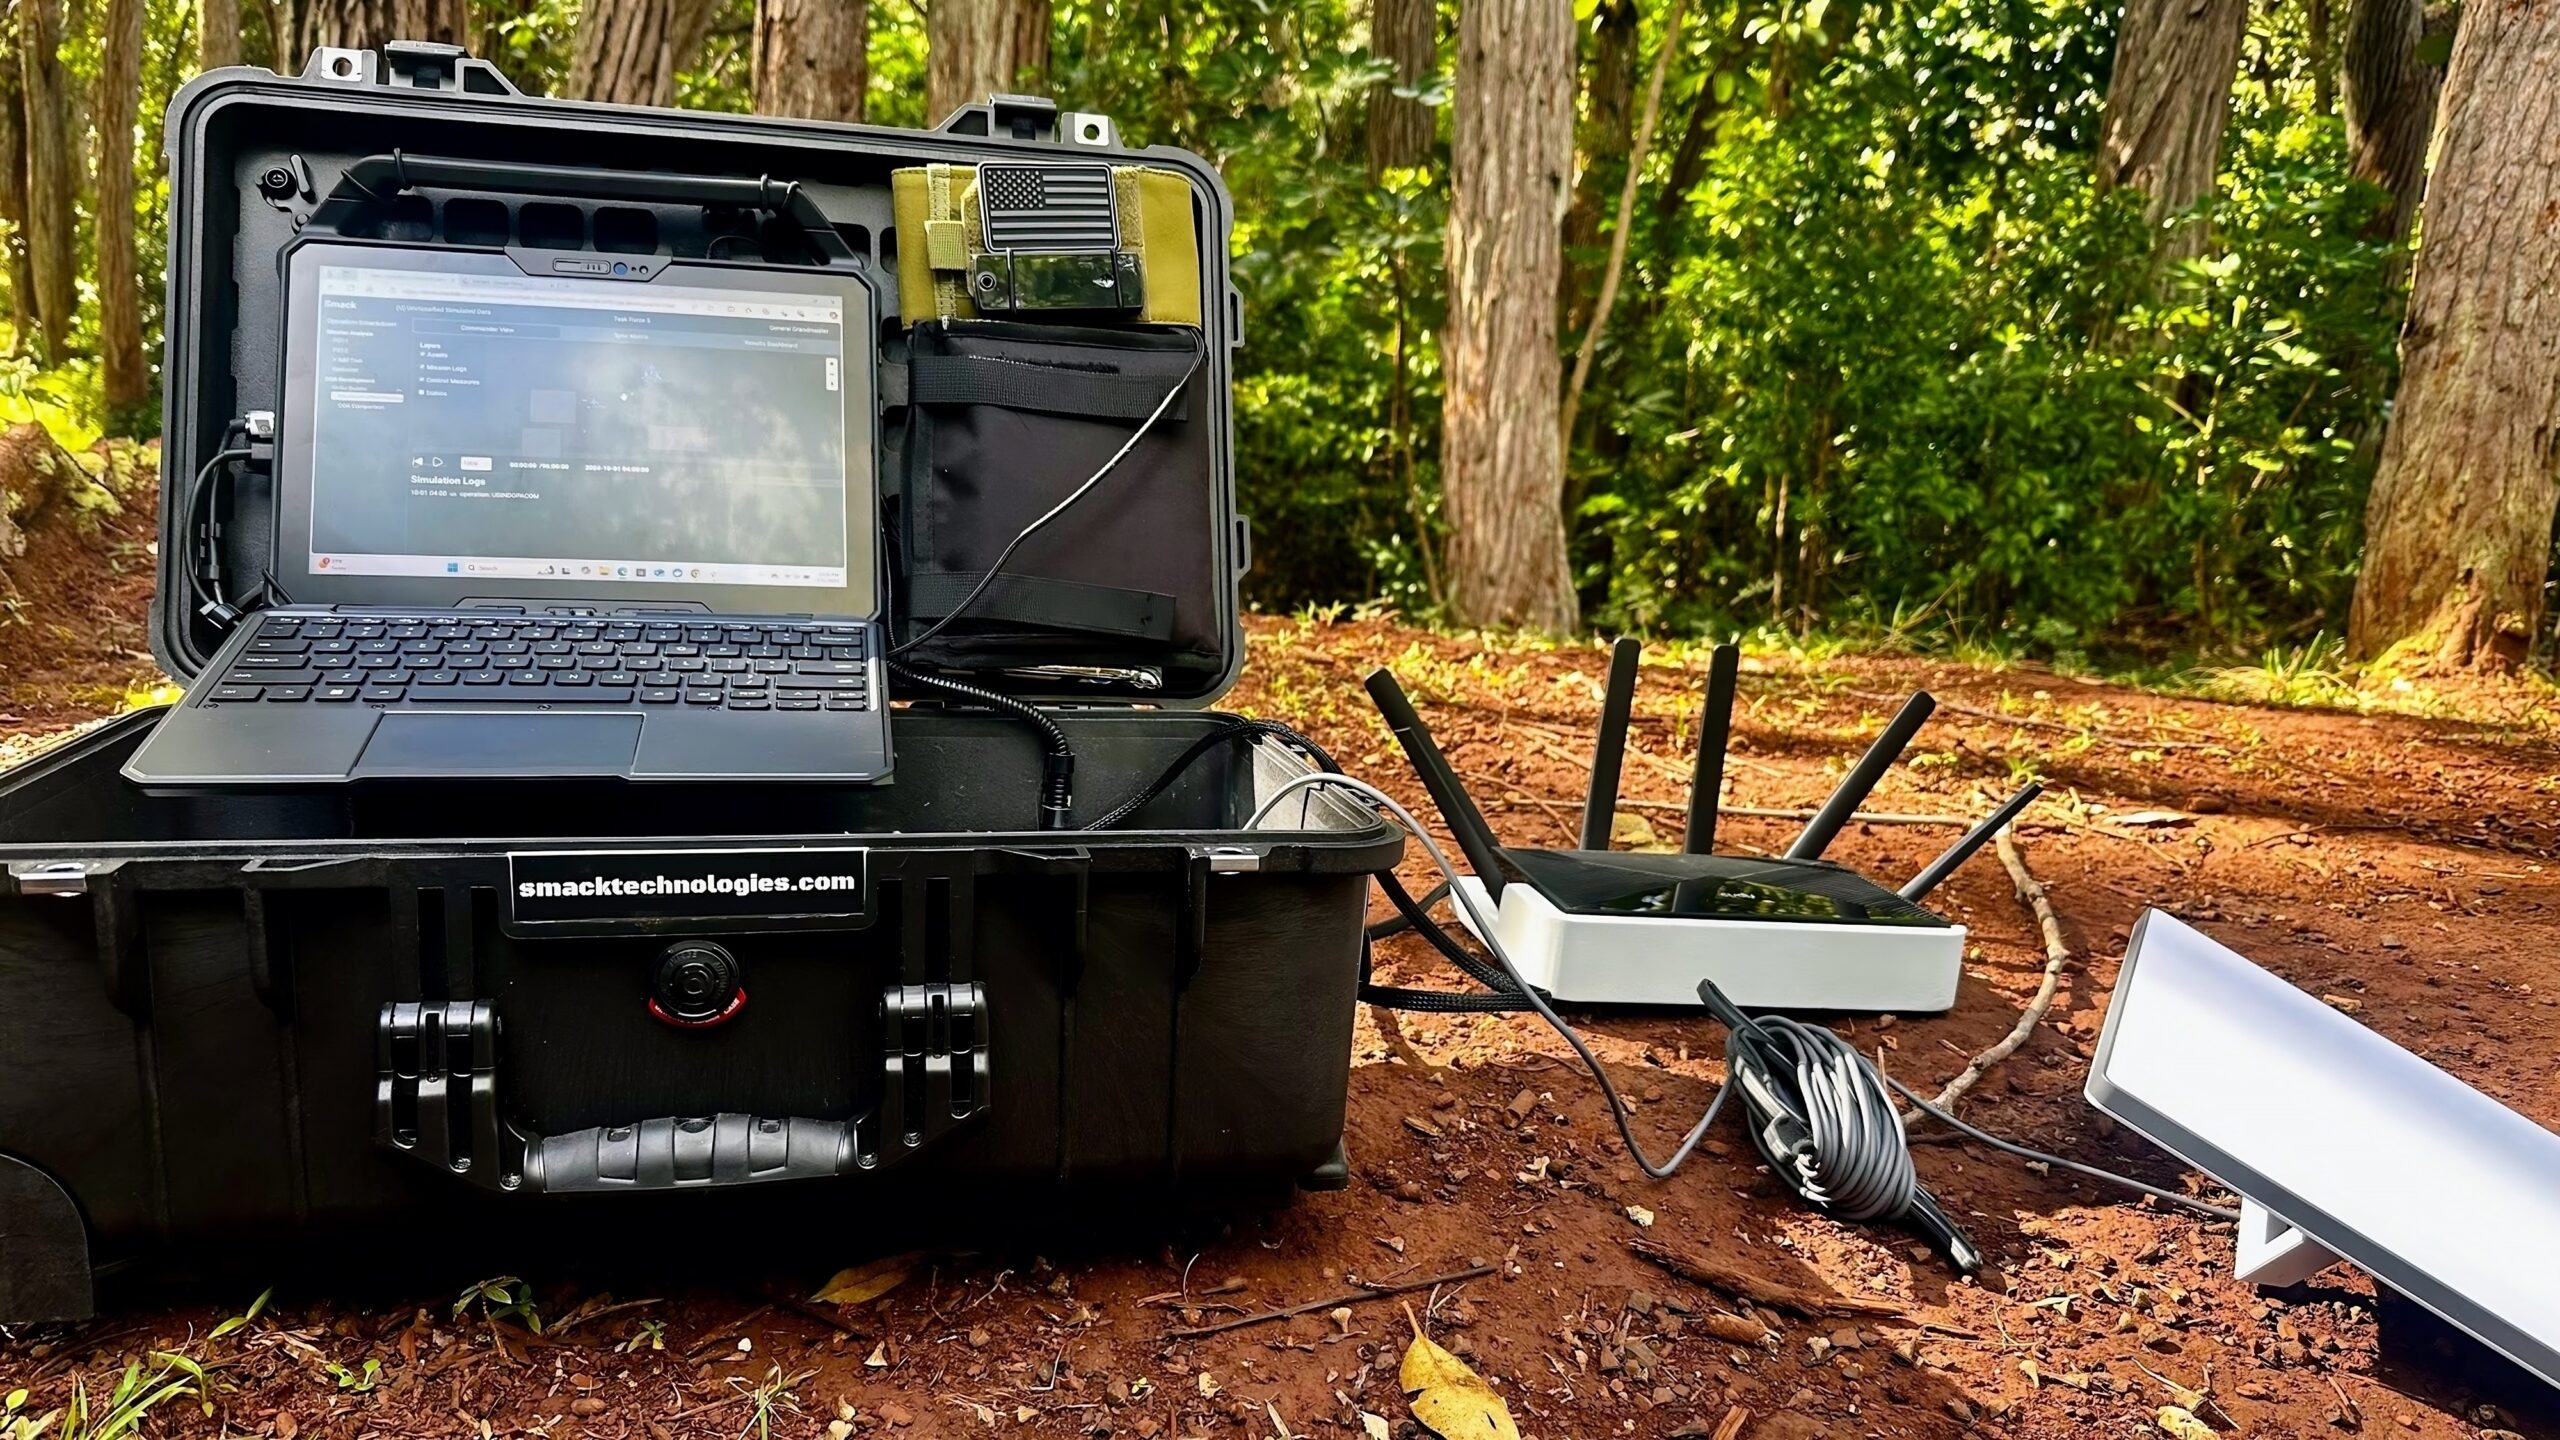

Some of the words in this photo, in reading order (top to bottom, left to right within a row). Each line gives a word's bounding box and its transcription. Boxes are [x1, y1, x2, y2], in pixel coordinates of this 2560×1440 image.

[324, 299, 357, 309] Smack
[420, 342, 441, 350] Layers
[451, 365, 467, 373] Logs
[450, 378, 480, 386] Measures
[411, 474, 461, 485] Simulation
[462, 477, 486, 487] Logs
[518, 873, 855, 898] smacktechnologies.com
